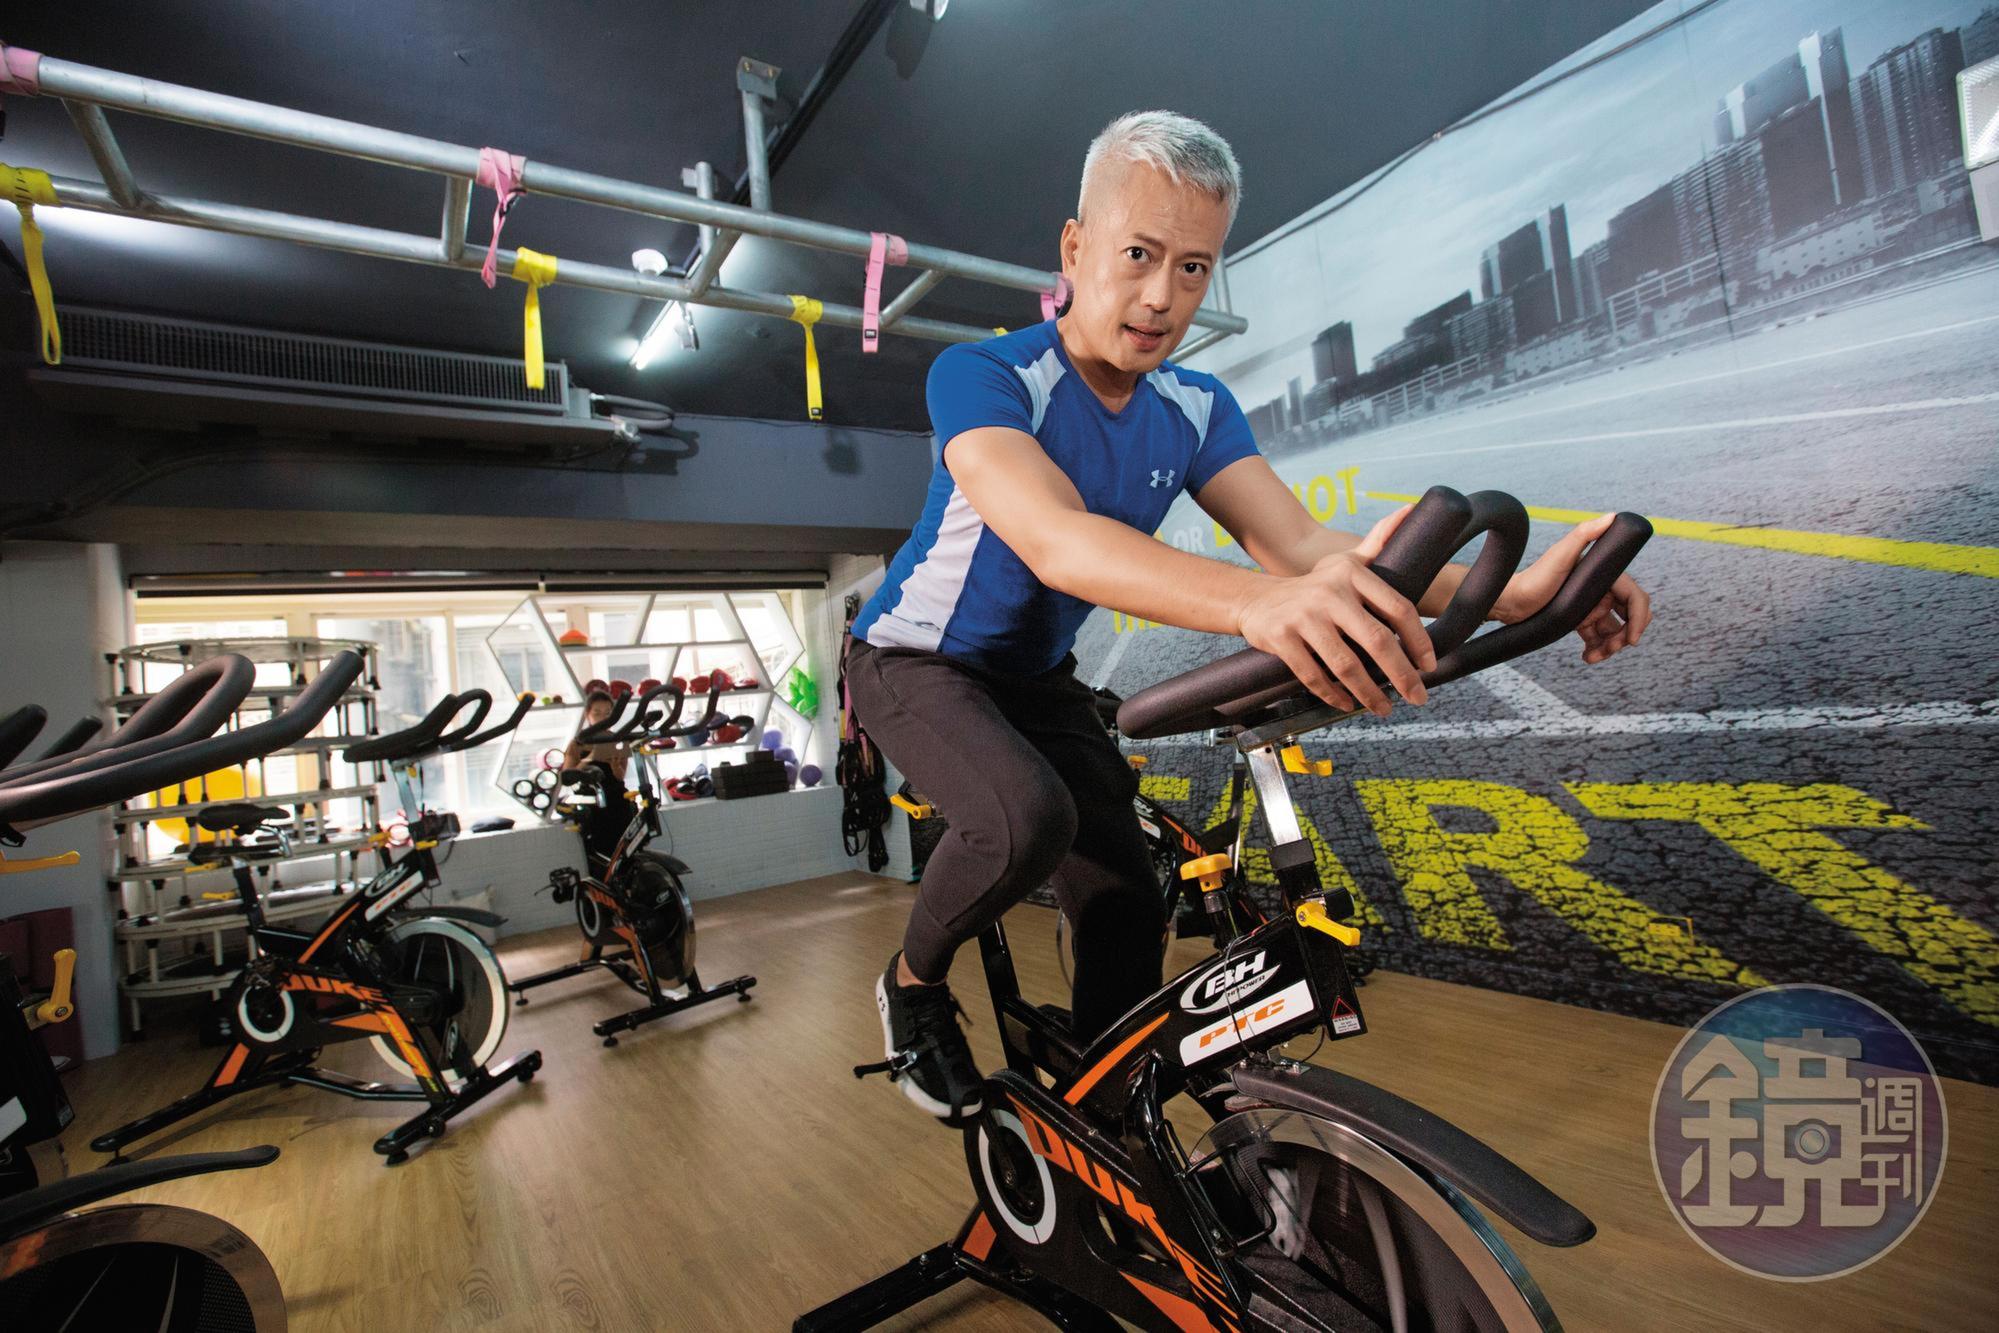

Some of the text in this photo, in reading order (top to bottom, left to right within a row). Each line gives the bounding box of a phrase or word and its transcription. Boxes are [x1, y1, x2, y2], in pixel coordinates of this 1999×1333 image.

[1292, 465, 1361, 524] OT
[1172, 526, 1206, 552] OR
[1204, 950, 1267, 999] BH
[1199, 998, 1286, 1049] PTC
